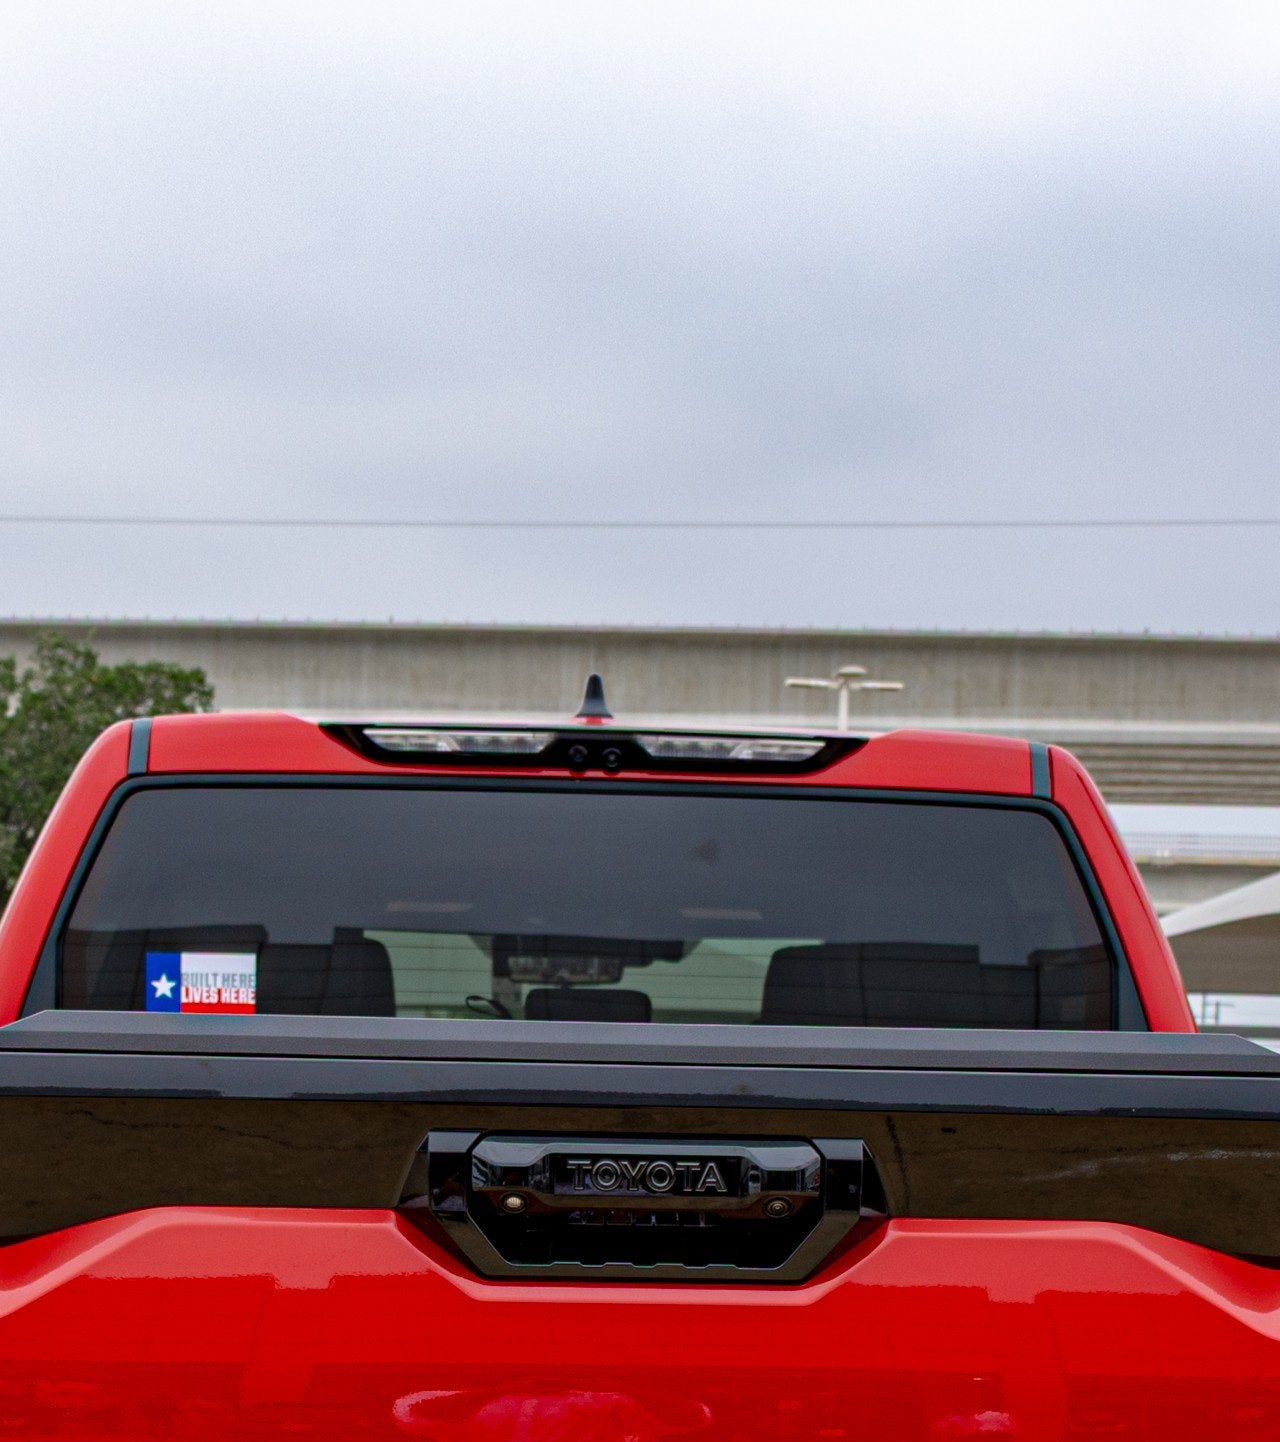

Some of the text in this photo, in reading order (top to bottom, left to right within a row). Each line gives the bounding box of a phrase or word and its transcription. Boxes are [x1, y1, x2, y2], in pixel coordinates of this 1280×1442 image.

[181, 972, 256, 989] BUILT HERE
[181, 986, 256, 1004] LIVES HERE
[566, 1159, 727, 1193] TOYOTA
